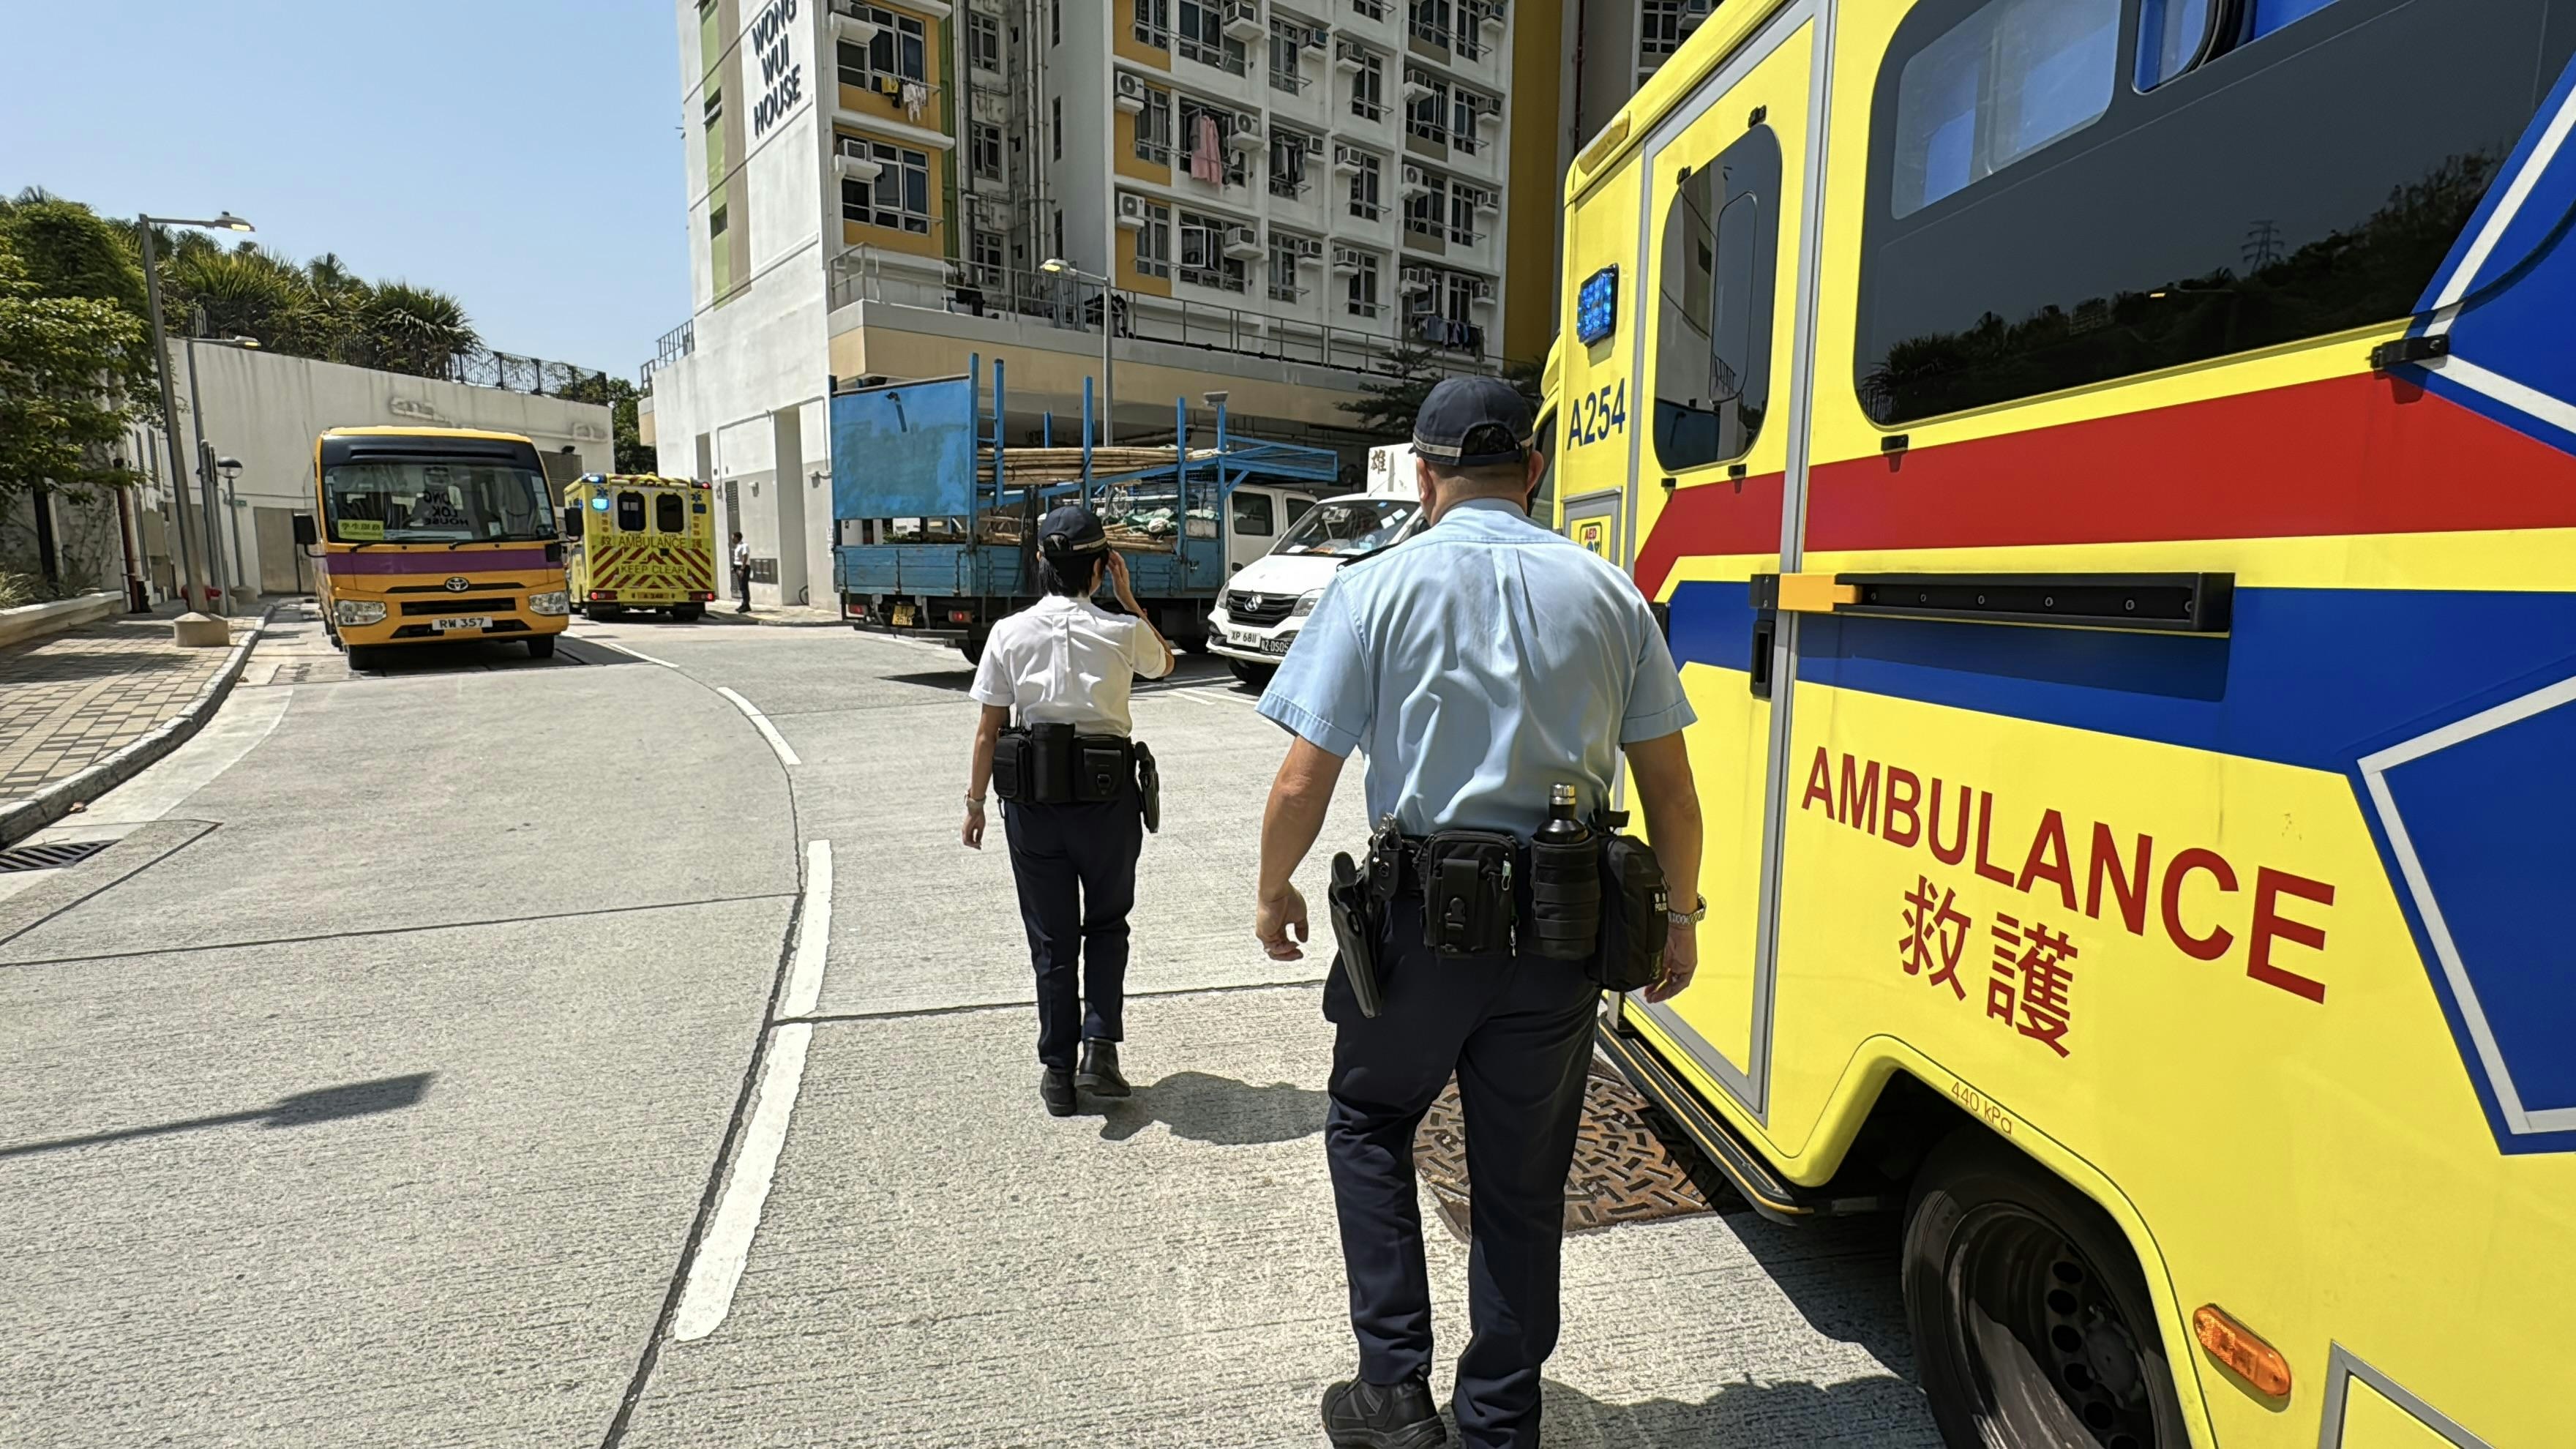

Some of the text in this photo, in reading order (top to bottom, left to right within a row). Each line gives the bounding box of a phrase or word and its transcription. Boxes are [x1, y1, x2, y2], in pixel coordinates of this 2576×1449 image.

[752, 0, 796, 57] WONG
[761, 34, 790, 89] WUI
[754, 64, 801, 139] HOUSE
[1567, 378, 1625, 451] A254
[618, 536, 686, 548] AMBULANCE
[1584, 528, 1597, 540] AED
[621, 565, 685, 574] KEEP CLEAR
[439, 618, 484, 628] RW 357
[1232, 631, 1257, 643] XP 6811
[1801, 746, 2335, 1005] AMBULANCE
[1898, 874, 2079, 1059] 救護
[1951, 1081, 2012, 1136] 440 kPa
